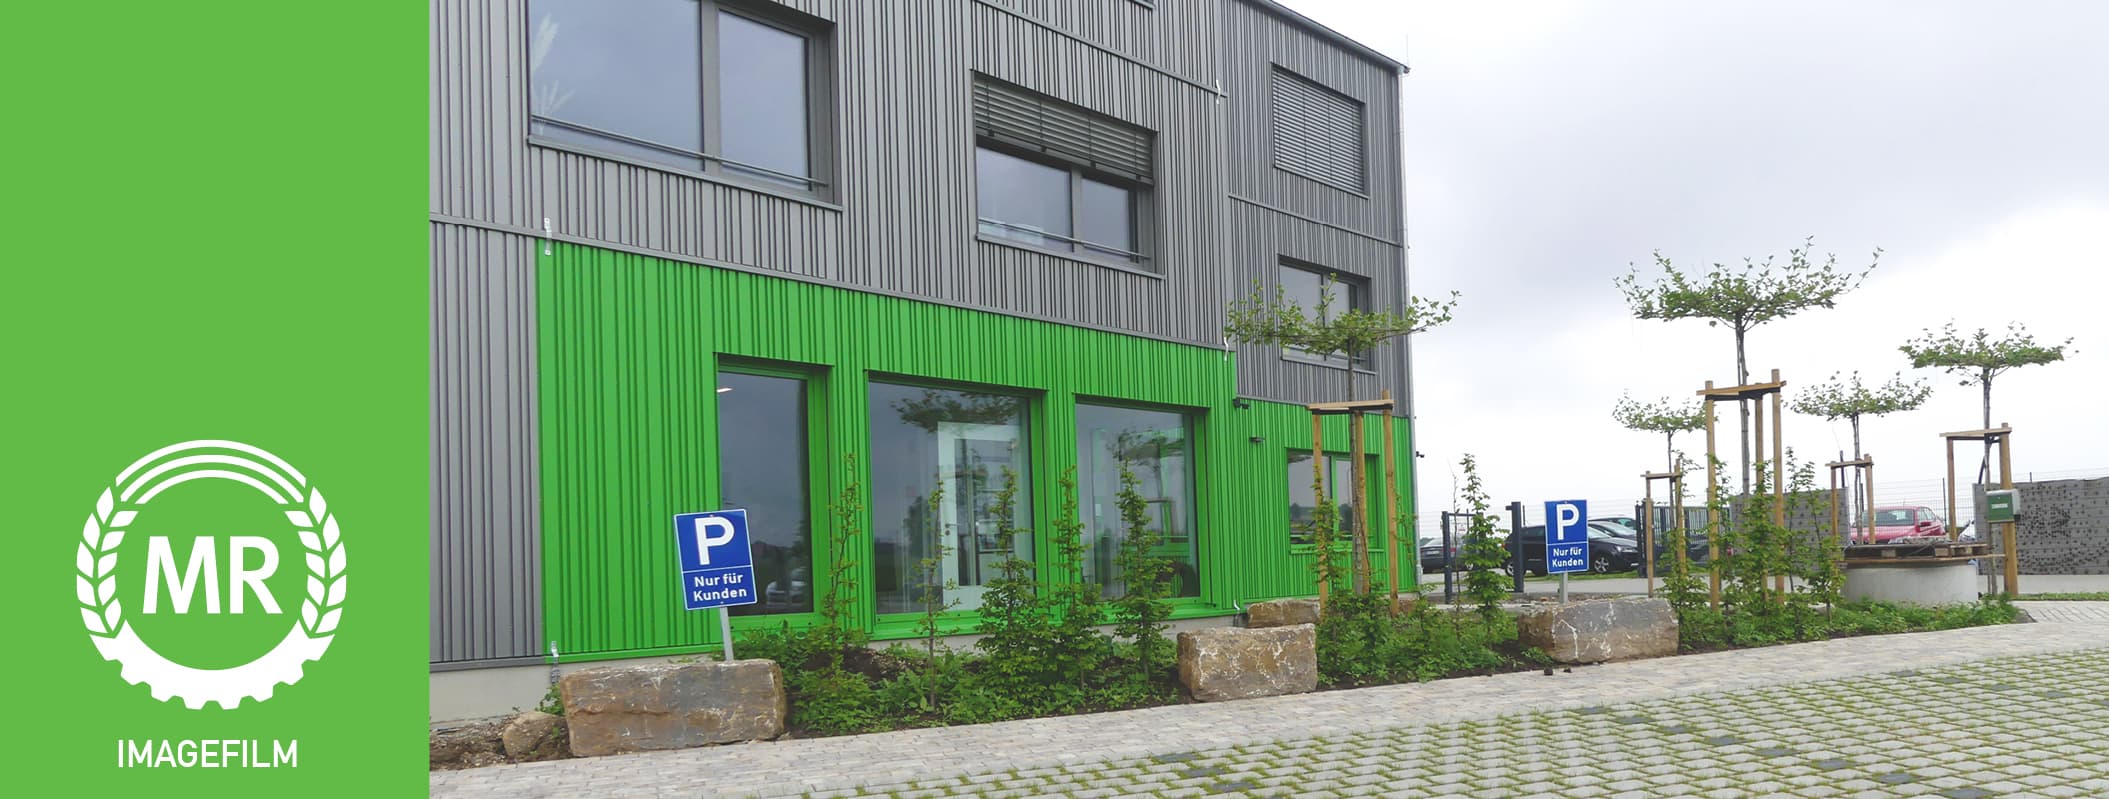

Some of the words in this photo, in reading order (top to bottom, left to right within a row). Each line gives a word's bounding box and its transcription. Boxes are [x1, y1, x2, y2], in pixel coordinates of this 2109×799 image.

[1556, 503, 1580, 541] P
[694, 516, 735, 566] P
[1553, 548, 1568, 557] Nur
[1570, 547, 1582, 556] für
[1552, 558, 1583, 568] Kunden
[694, 576, 720, 588] Nur
[722, 573, 743, 585] für
[693, 588, 747, 602] Kunden
